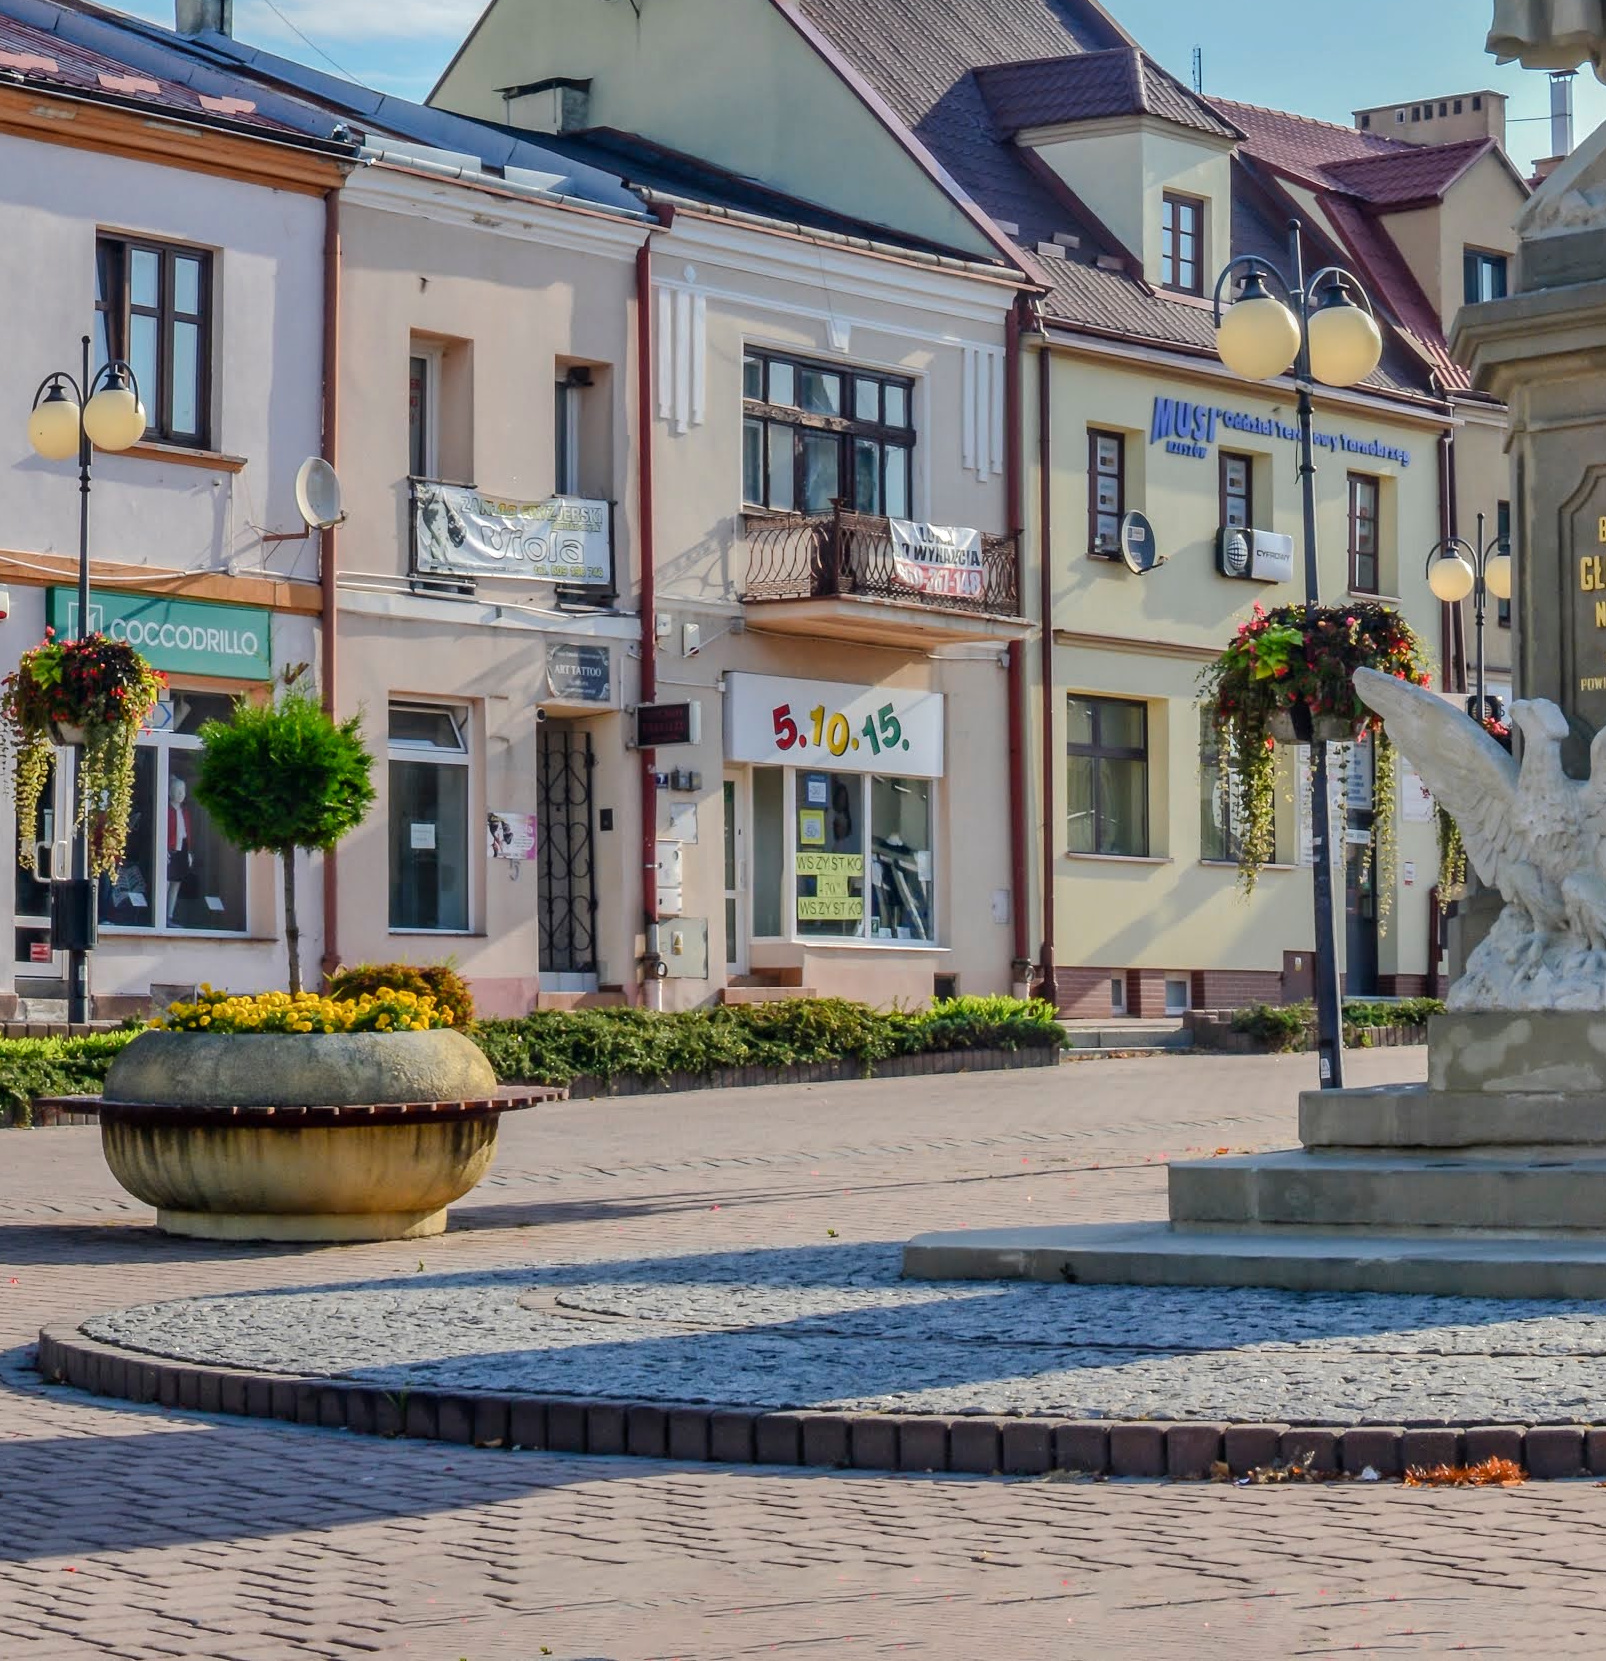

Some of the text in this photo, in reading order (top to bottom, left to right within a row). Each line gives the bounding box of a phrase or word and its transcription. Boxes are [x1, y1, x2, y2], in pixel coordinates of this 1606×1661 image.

[1275, 423, 1338, 452] Tereowy
[1340, 434, 1411, 467] Tarnobrzeg
[481, 525, 584, 564] Viola
[110, 618, 258, 656] COCCODRILLO
[571, 665, 602, 677] TATTOO
[799, 901, 863, 916] WSZYSTKO
